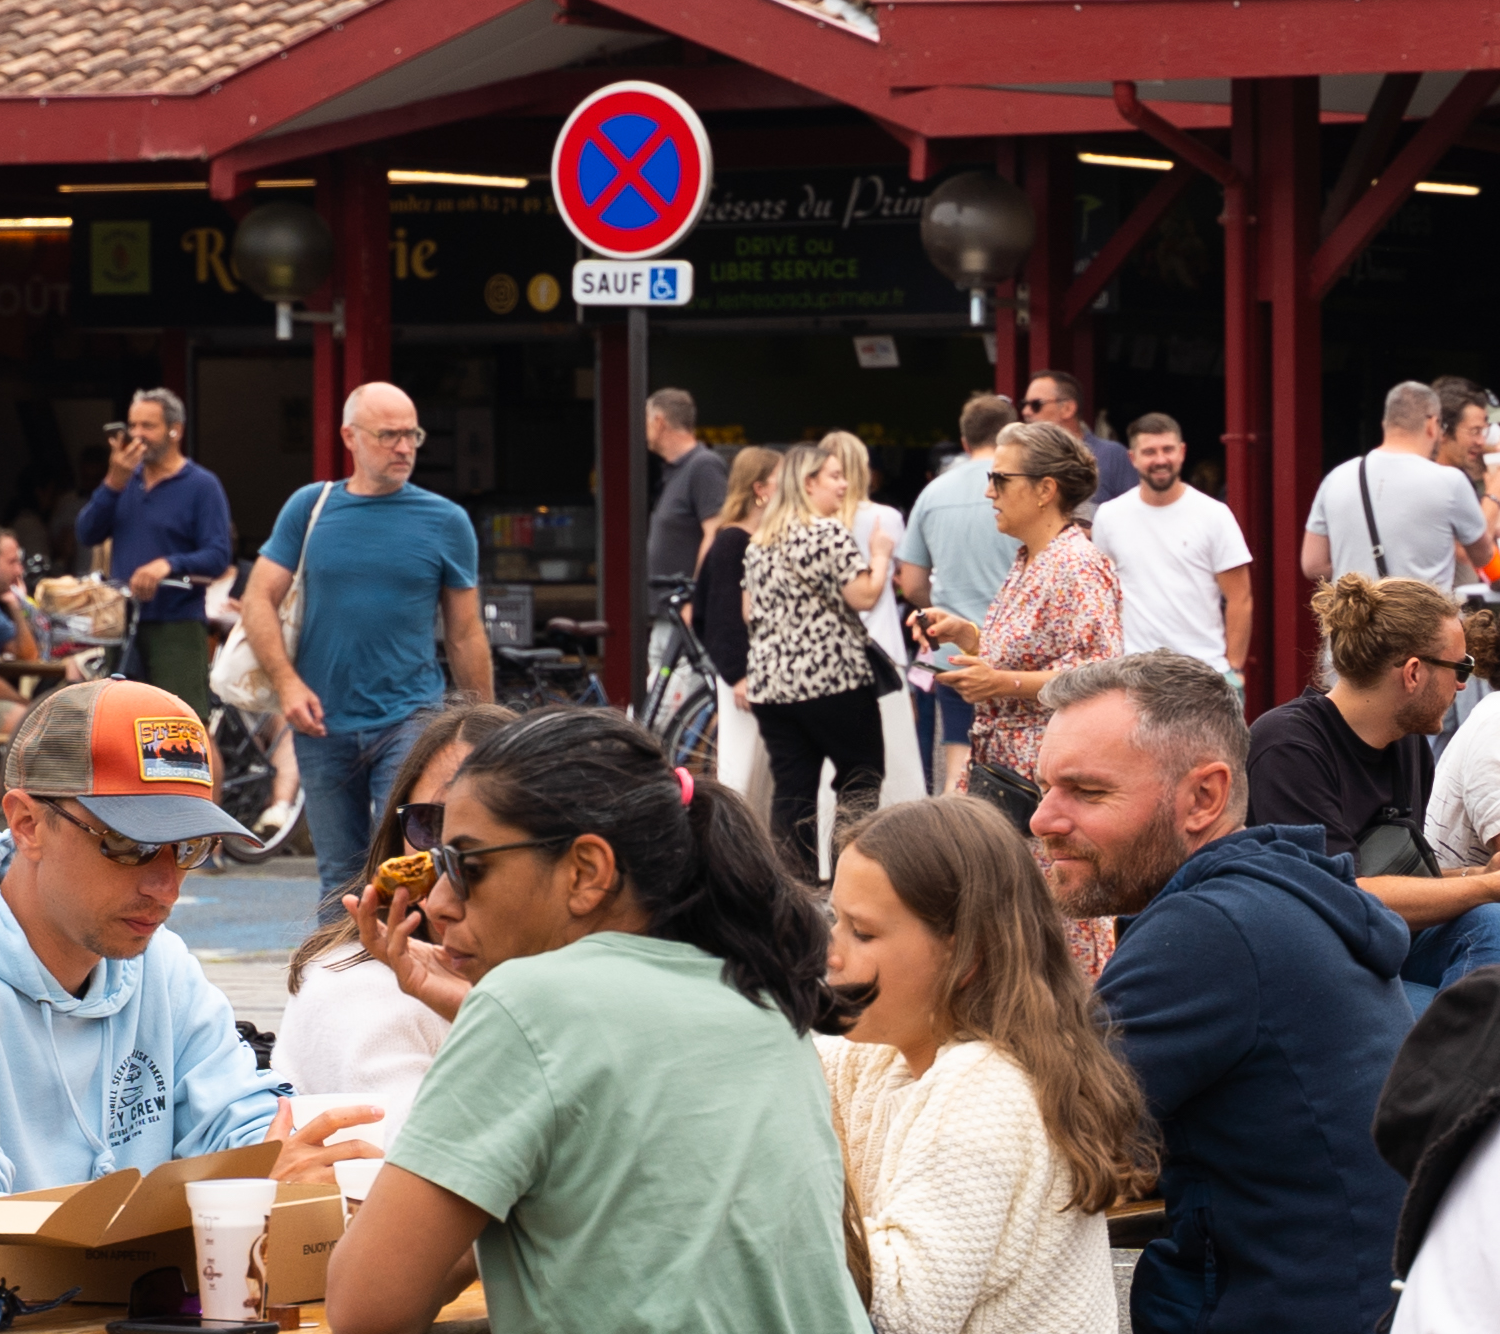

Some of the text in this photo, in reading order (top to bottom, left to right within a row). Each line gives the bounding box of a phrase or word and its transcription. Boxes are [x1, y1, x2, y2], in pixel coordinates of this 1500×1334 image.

[799, 183, 834, 219] du
[735, 235, 834, 256] DRIVE ou
[709, 259, 859, 283] LIBRE SERVICE
[582, 272, 642, 294] SAUF
[147, 1059, 167, 1093] TAKERS
[130, 1094, 167, 1121] CREW
[85, 1249, 107, 1261] BON
[303, 1244, 326, 1256] ENJOY
